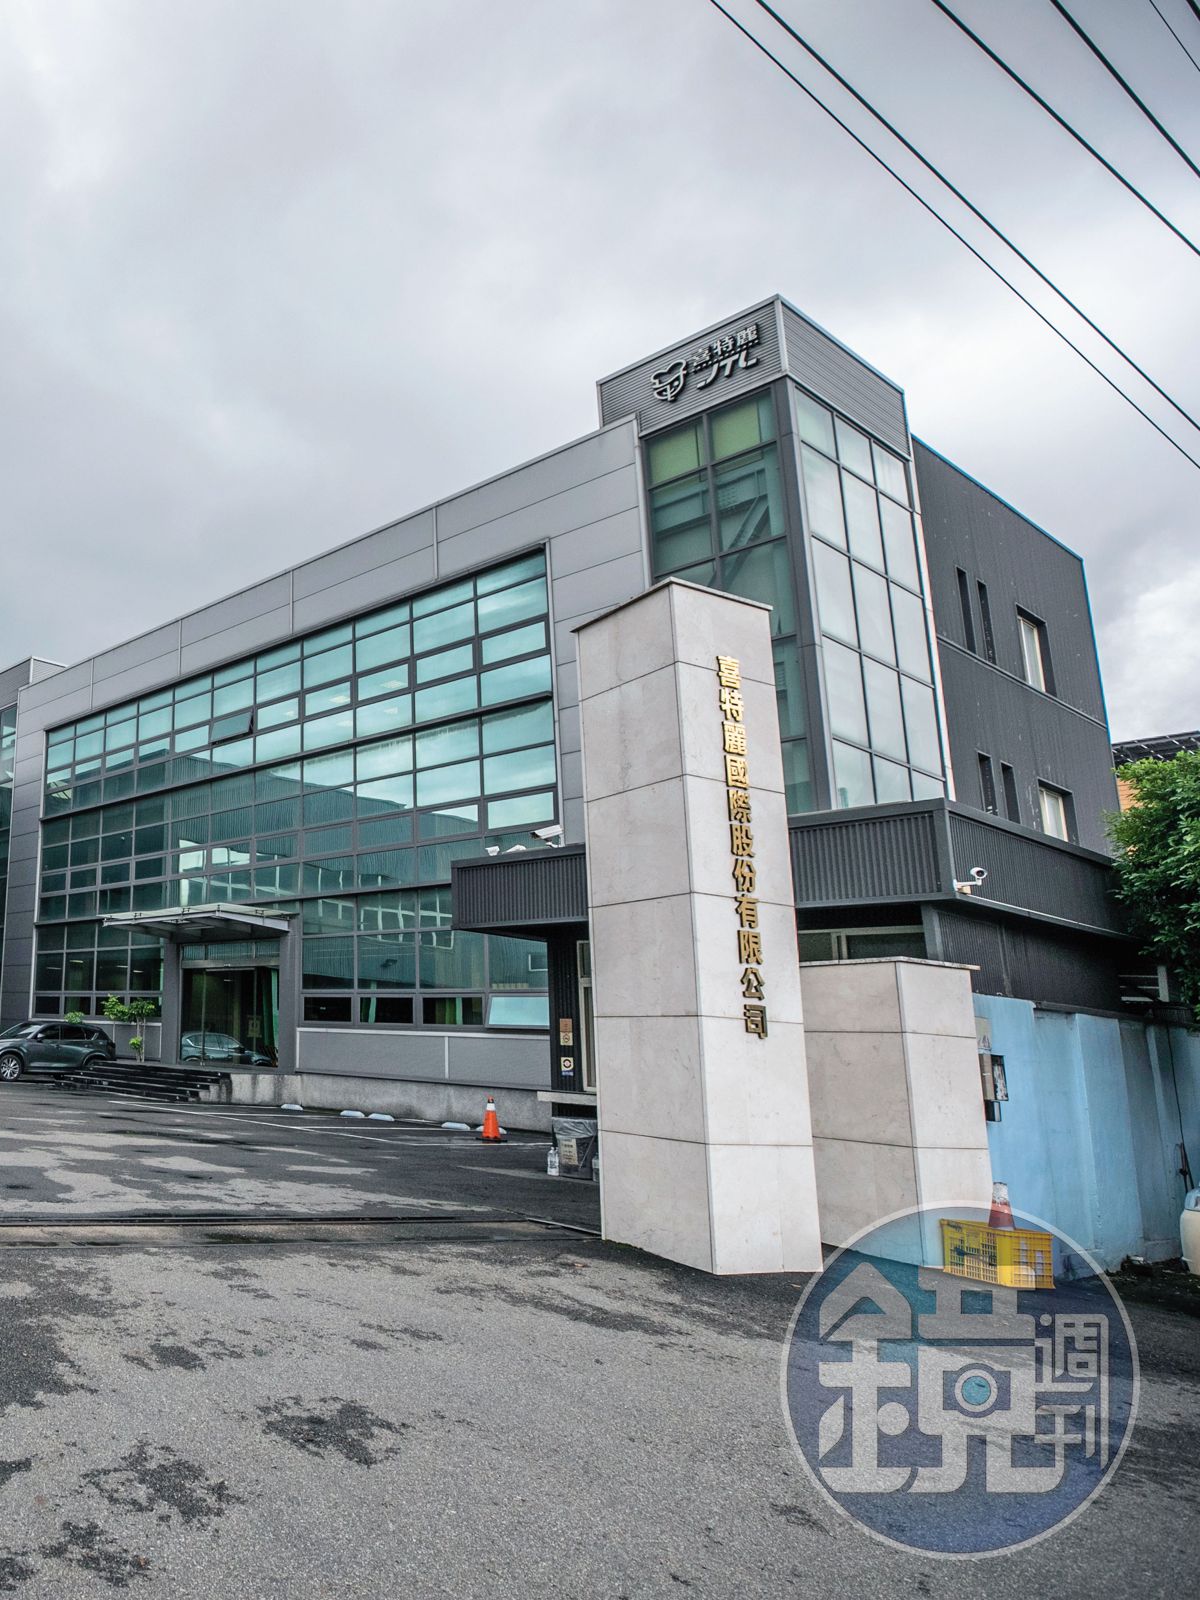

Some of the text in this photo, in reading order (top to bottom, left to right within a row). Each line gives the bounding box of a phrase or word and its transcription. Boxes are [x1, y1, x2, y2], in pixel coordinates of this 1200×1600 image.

[696, 350, 759, 389] JTL
[716, 655, 768, 1040] 喜特麗國際股份有限公司
